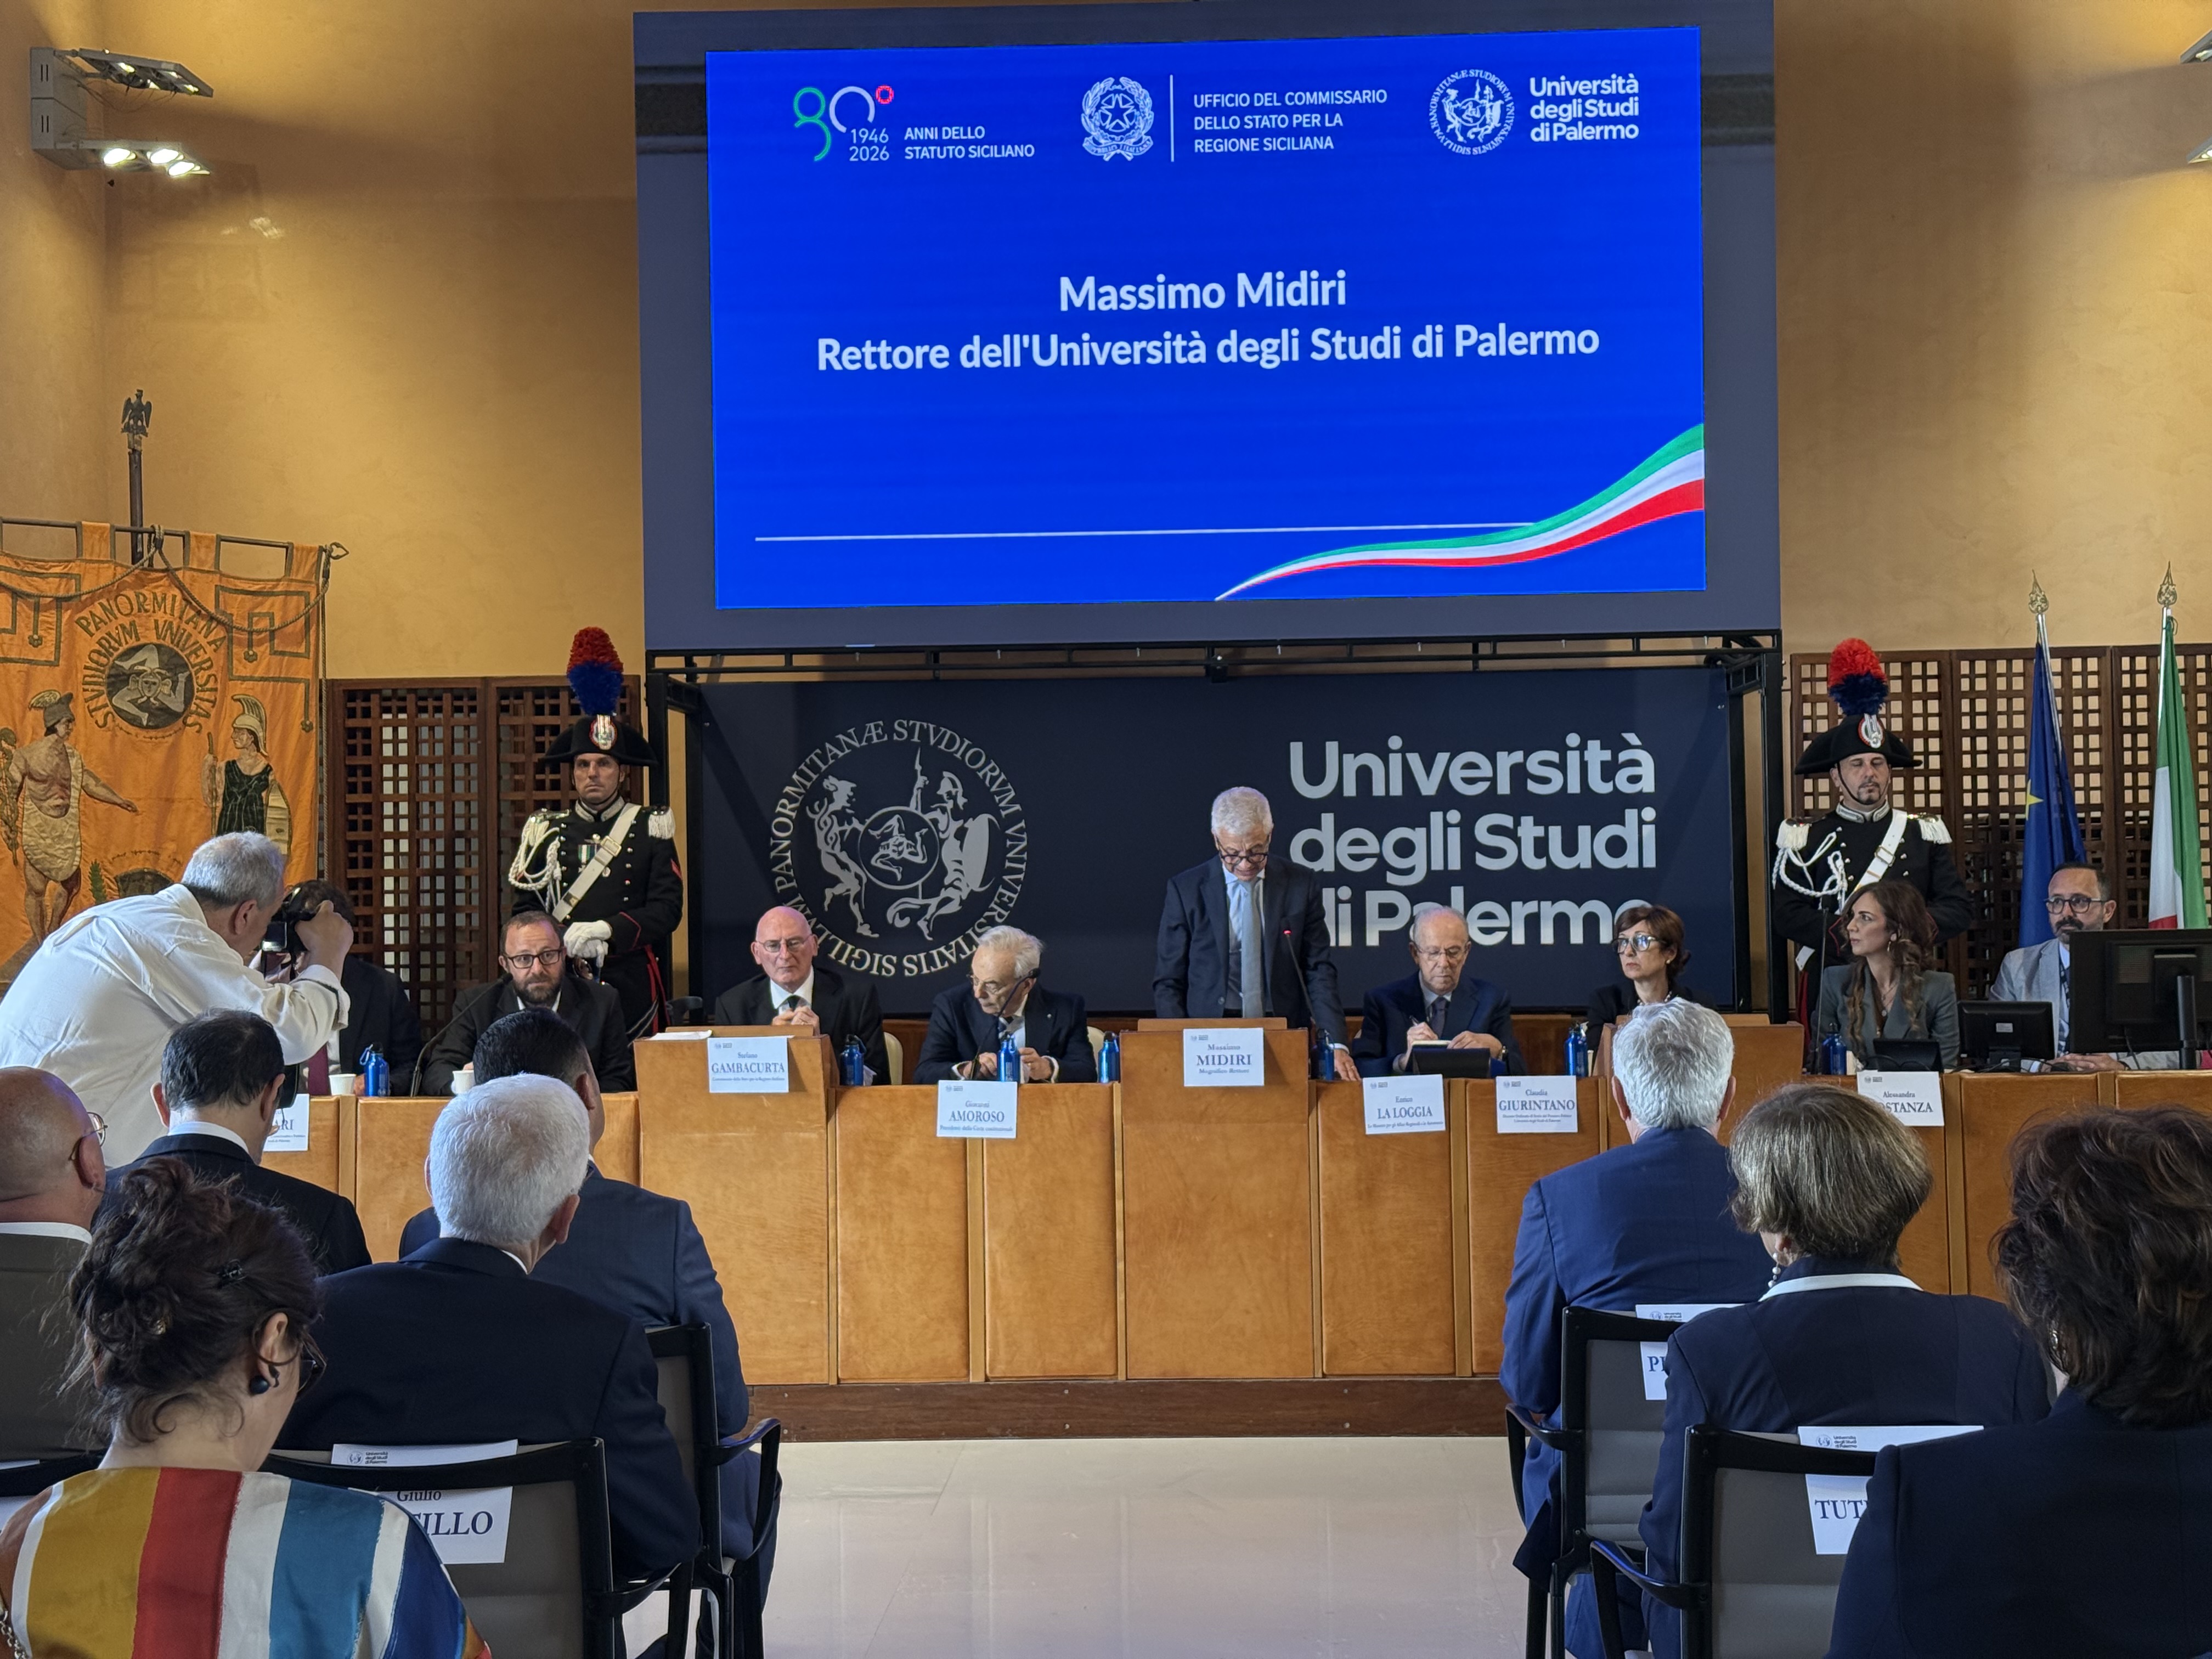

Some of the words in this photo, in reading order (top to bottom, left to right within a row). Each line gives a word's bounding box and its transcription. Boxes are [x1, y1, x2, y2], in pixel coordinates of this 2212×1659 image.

[1530, 73, 1639, 97] Università
[1194, 93, 1250, 108] UFFICIO
[1254, 92, 1282, 107] DEL
[1285, 89, 1387, 106] COMMISSARIO
[1530, 98, 1582, 122] degli
[1584, 96, 1639, 117] Studi
[1194, 116, 1240, 131] DELLO
[1244, 114, 1289, 129] STATO
[1293, 114, 1321, 128] PER
[1325, 113, 1343, 127] LA
[851, 127, 889, 144] 1946
[904, 127, 938, 140] ANNI
[942, 126, 985, 139] DELLO
[1530, 122, 1550, 142] di
[1553, 121, 1639, 142] Palermo
[905, 145, 966, 160] STATUTO
[968, 144, 1035, 158] SICILIANO
[1194, 138, 1259, 153] REGIONE
[1263, 136, 1334, 151] SICILIANA
[849, 145, 889, 162] 2026
[1060, 274, 1226, 312] Massimo
[1237, 269, 1346, 308] Midiri
[818, 338, 950, 370] Rettore
[960, 331, 1207, 369] dell'Università
[1217, 328, 1300, 370] degli
[1310, 326, 1402, 362] Studi
[1412, 324, 1444, 359] di
[1455, 323, 1600, 358] Palermo
[1289, 732, 1656, 799] Università
[770, 720, 889, 893] PANORMITANÆ
[893, 719, 1023, 818] STVDIORVM
[1289, 809, 1462, 886] degli
[1474, 806, 1656, 871] Studi
[711, 1063, 785, 1074] GAMBACURTA
[1196, 1054, 1252, 1066] MIDIRI
[1378, 1108, 1391, 1119] LA
[1392, 1106, 1433, 1118] LOGGIA
[1499, 1099, 1575, 1111] GIURINTANO
[949, 1110, 1005, 1122] AMOROSO
[397, 1490, 442, 1502] Giulio
[1815, 1499, 1868, 1520] TUT
